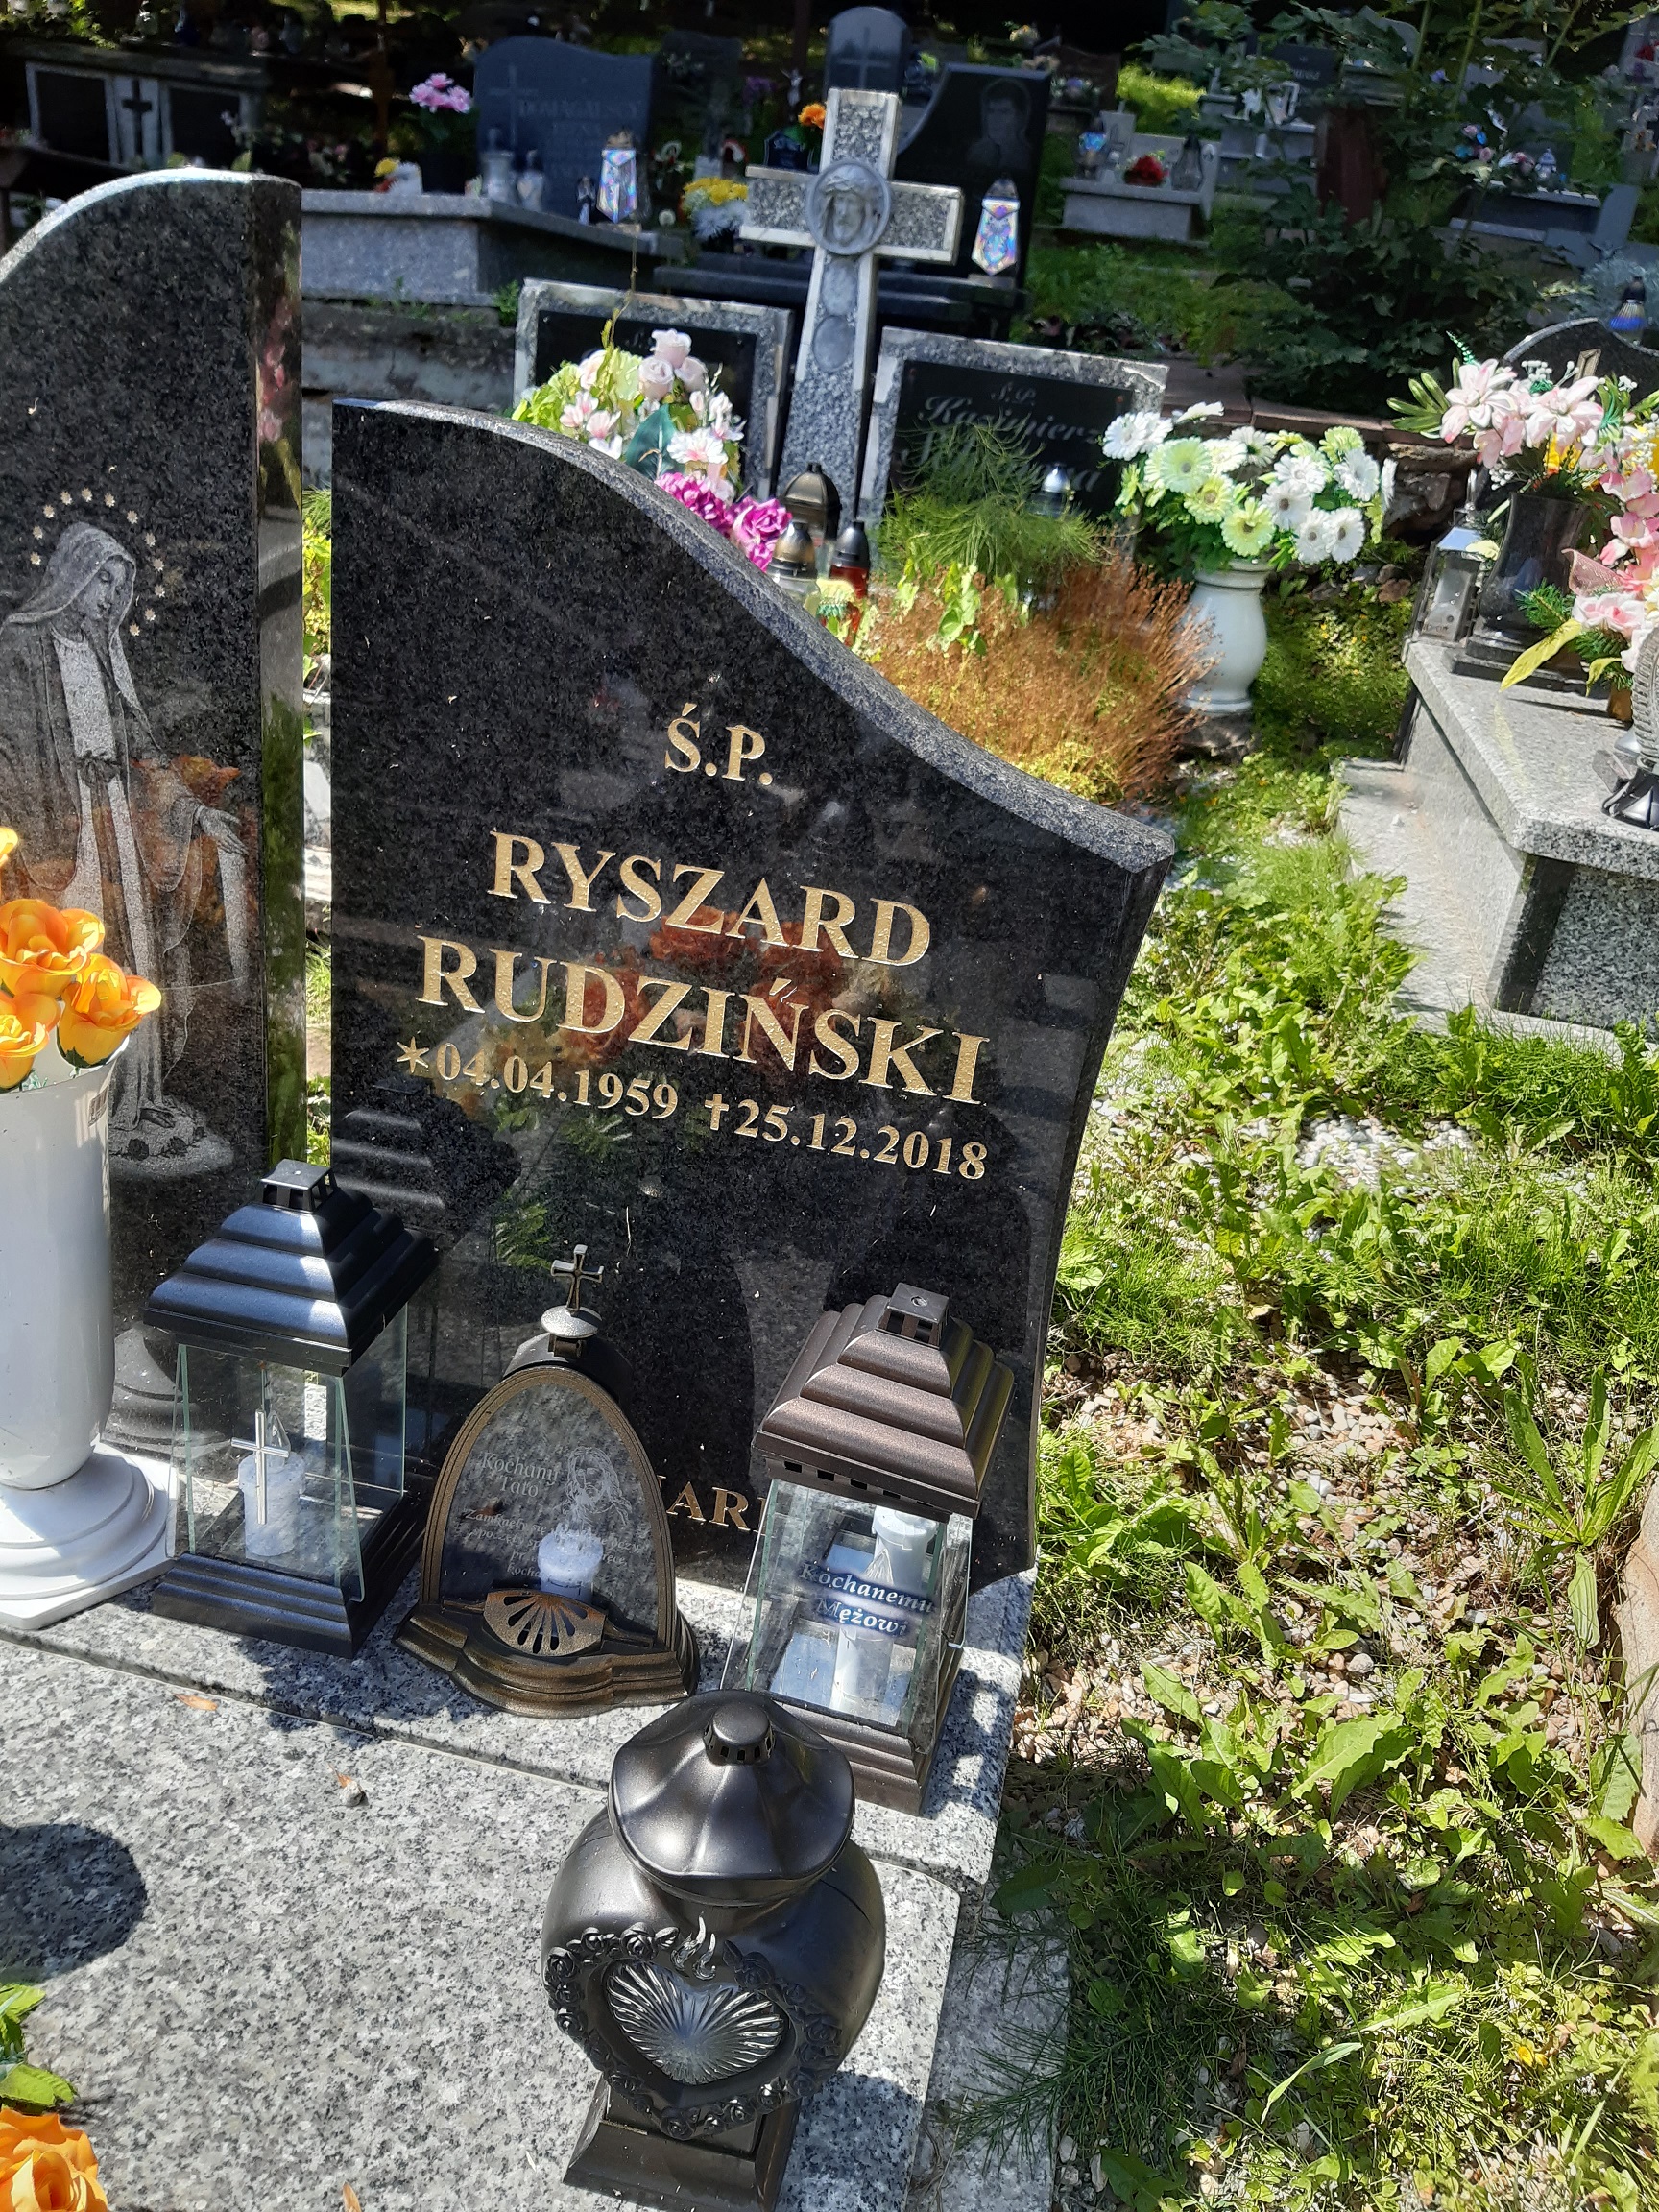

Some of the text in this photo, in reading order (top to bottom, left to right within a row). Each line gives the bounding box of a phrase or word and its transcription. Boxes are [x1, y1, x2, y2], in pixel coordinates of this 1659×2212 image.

[664, 703, 773, 785] Ś.P.
[487, 830, 931, 966] RYSZARD
[416, 935, 991, 1106] RUDZIŃSKI
[436, 1043, 988, 1180] 04.04.1959 25.12.2018
[481, 1451, 561, 1486] Kochany
[499, 1475, 540, 1498] Tato
[799, 1562, 935, 1614] Kochanemu
[816, 1597, 908, 1636] Mężowi
